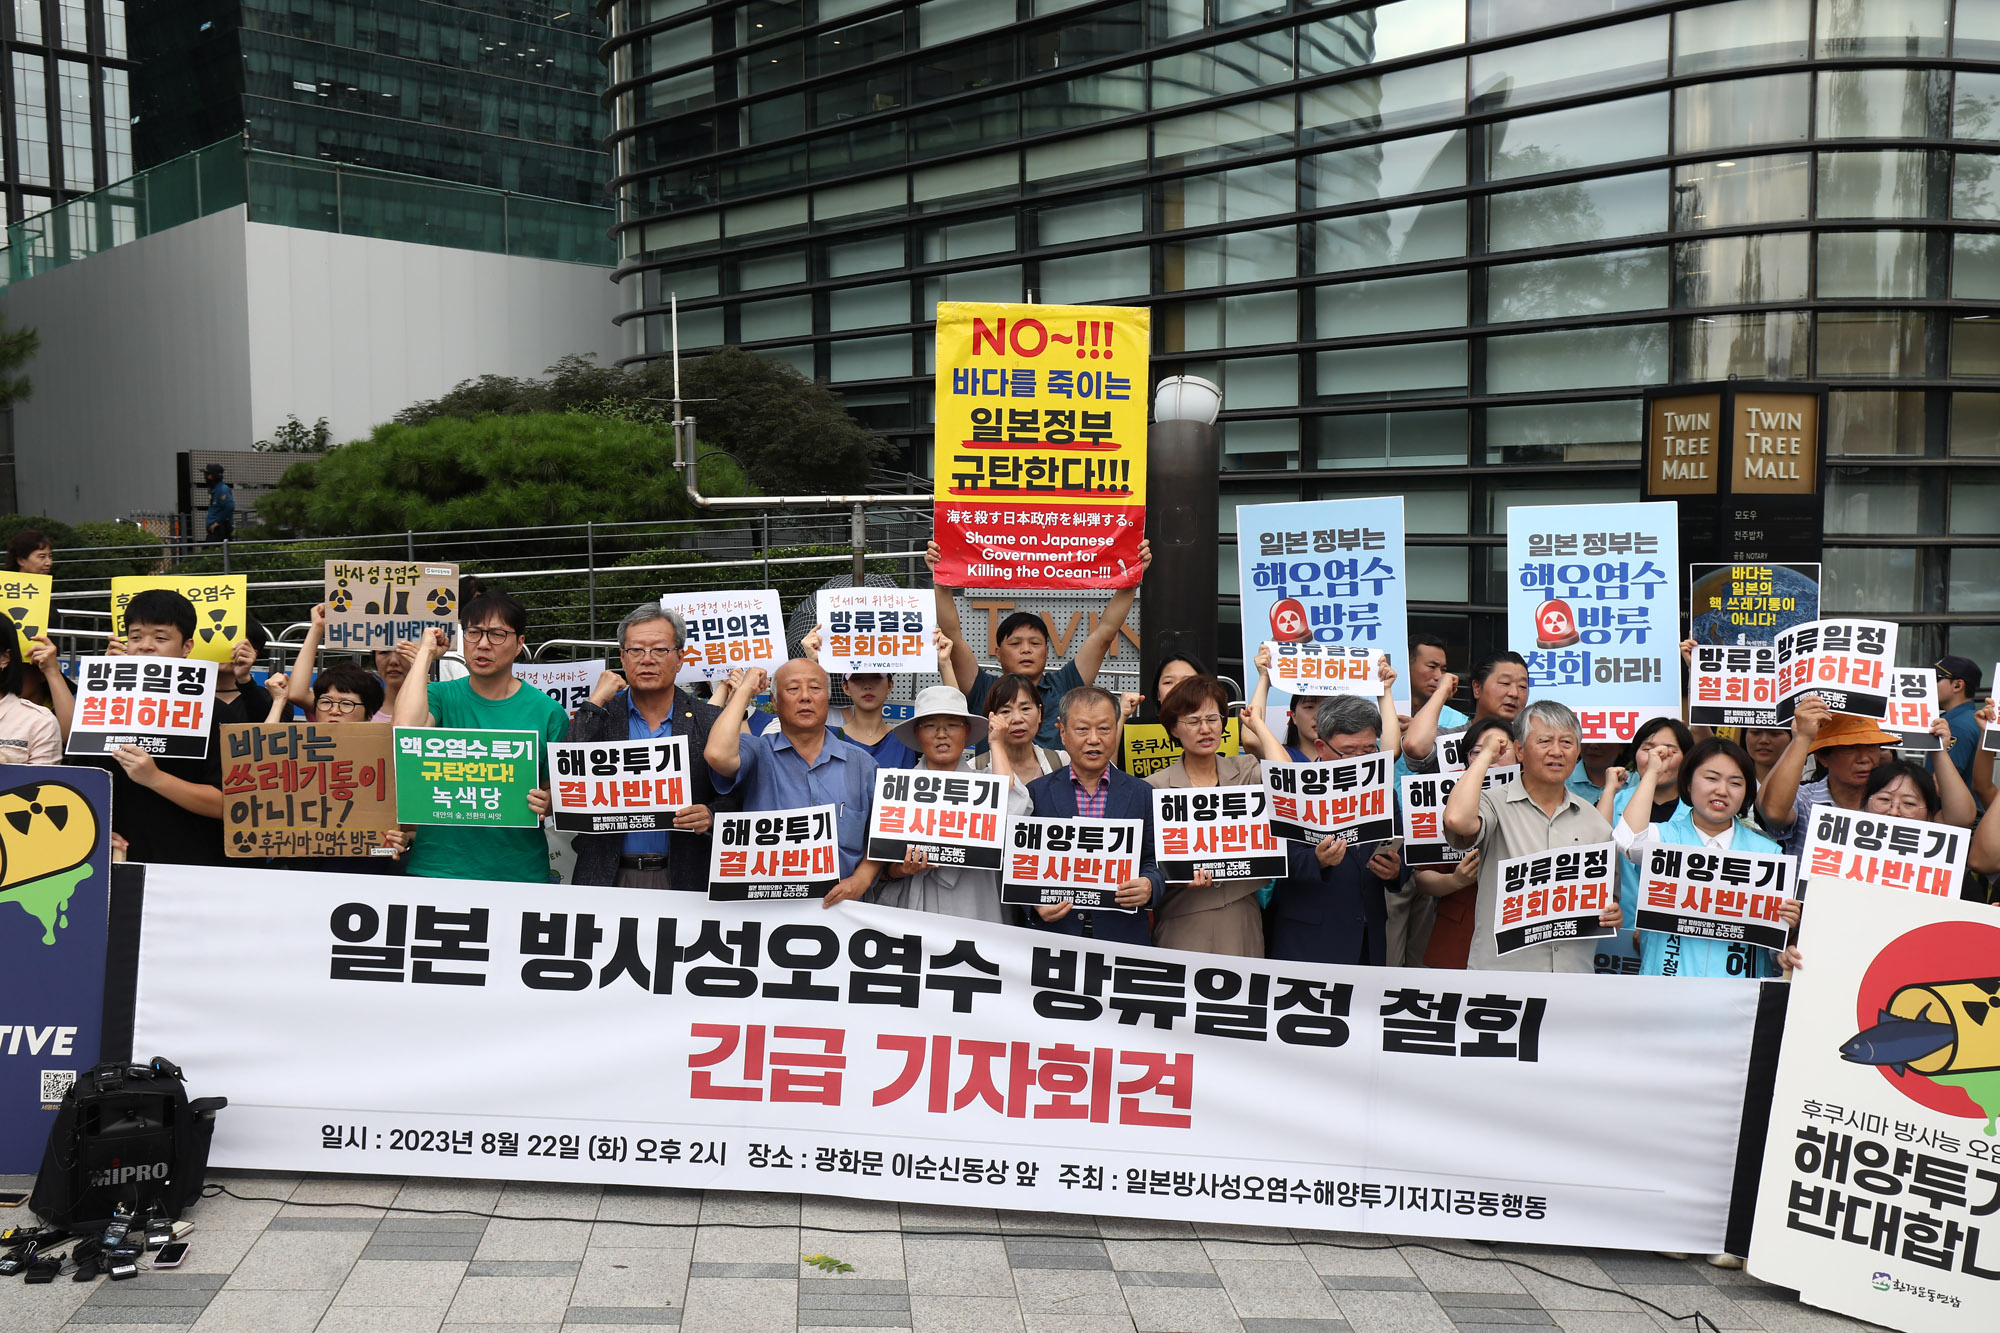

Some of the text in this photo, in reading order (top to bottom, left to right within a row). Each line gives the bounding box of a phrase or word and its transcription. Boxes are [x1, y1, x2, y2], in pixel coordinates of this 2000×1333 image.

[953, 368, 1131, 400] 바다를 죽이는
[970, 408, 1113, 446] 일본정부
[952, 455, 1130, 493] 규탄한다!!!
[946, 510, 1134, 528] 海を殺す日本政府を糾弾する。
[1735, 510, 1757, 520] 모도우
[965, 532, 1114, 548] Shame on Japanese
[982, 548, 1097, 562] Government for
[1260, 528, 1385, 556] 일본 정부는
[1528, 532, 1658, 556] 일본 정부는
[1746, 552, 1768, 560] NOTARY
[967, 564, 1112, 580] Killing the Ocean~!!!
[1251, 557, 1396, 600] 핵오염수
[1518, 560, 1668, 600] 핵오염수
[1732, 566, 1773, 580] 바다는
[0, 582, 40, 600] 염수
[187, 584, 236, 602] 오염수
[872, 594, 919, 608] 위협하는
[1709, 597, 1795, 611] 핵 쓰레기통이
[1732, 582, 1773, 596] 일본의
[686, 614, 770, 642] 국민의견
[830, 611, 923, 633] 방류결정
[1310, 602, 1382, 642] 방류
[1578, 606, 1652, 644] 방류
[1731, 612, 1776, 626] 아니다!
[683, 638, 773, 666] 수렴하라
[830, 634, 924, 656] 철회하라
[1699, 648, 1775, 673] 방류일
[1778, 626, 1886, 665] 방류일정
[87, 662, 207, 696] 방류일정
[1277, 657, 1370, 680] 철회하라
[1778, 656, 1884, 696] 철회하라
[1698, 676, 1776, 703] 철회하
[82, 696, 203, 730] 철회하라
[1574, 712, 1639, 740] 보당
[228, 726, 336, 762] 바다는
[556, 743, 681, 777] 해양투기
[224, 758, 386, 801] 쓰레기통이
[421, 761, 514, 783] 규탄한다!
[1269, 758, 1386, 795] 해양투기
[432, 786, 502, 810] 녹색당
[559, 777, 684, 808] 결사반대
[882, 774, 1000, 809] 해양투기
[1272, 788, 1384, 826] 결사반대
[231, 794, 354, 828] 아니다!
[432, 811, 453, 819] 대안의
[466, 812, 486, 820] 전환의
[488, 812, 502, 820] 씨앗
[879, 805, 996, 842] 결사반대
[259, 830, 312, 855] 후쿠시마
[312, 831, 348, 855] 오염수
[351, 831, 381, 855] 방류
[722, 812, 832, 846] 해양투기
[1014, 821, 1134, 854] 해양투기
[1162, 823, 1277, 855] 결사반대
[1817, 813, 1959, 864] 해양투기
[720, 845, 835, 877] 결사반대
[1012, 854, 1132, 885] 결사반대
[1505, 849, 1608, 893] 방류일정
[1651, 848, 1786, 892] 해양투기
[1810, 846, 1952, 897] 결사반대
[1502, 882, 1608, 926] 철회하라
[1648, 879, 1782, 924] 결사반대
[330, 902, 1547, 1062] 일본 방사성오염수 방류일정 철회
[688, 1023, 1194, 1129] 긴급 기자회견
[1802, 1099, 1888, 1136] 후쿠시마
[1894, 1120, 1961, 1153] 방사능
[321, 1124, 367, 1150] 일시
[389, 1129, 473, 1155] 2023년
[481, 1132, 519, 1157] 8월
[527, 1135, 580, 1159] 22일
[588, 1135, 628, 1163] (화)
[635, 1138, 682, 1164] 오후
[689, 1142, 727, 1166] 2시
[747, 1142, 793, 1168] 장소
[814, 1147, 883, 1176] 광화문
[892, 1153, 1008, 1185] 이순신동상
[1016, 1161, 1038, 1187] 앞
[1058, 1163, 1104, 1191] 주최
[1126, 1168, 1547, 1220] 일본방사성오염수해양투기저지공동행동
[1892, 1278, 1962, 1308] 환경운동연합
